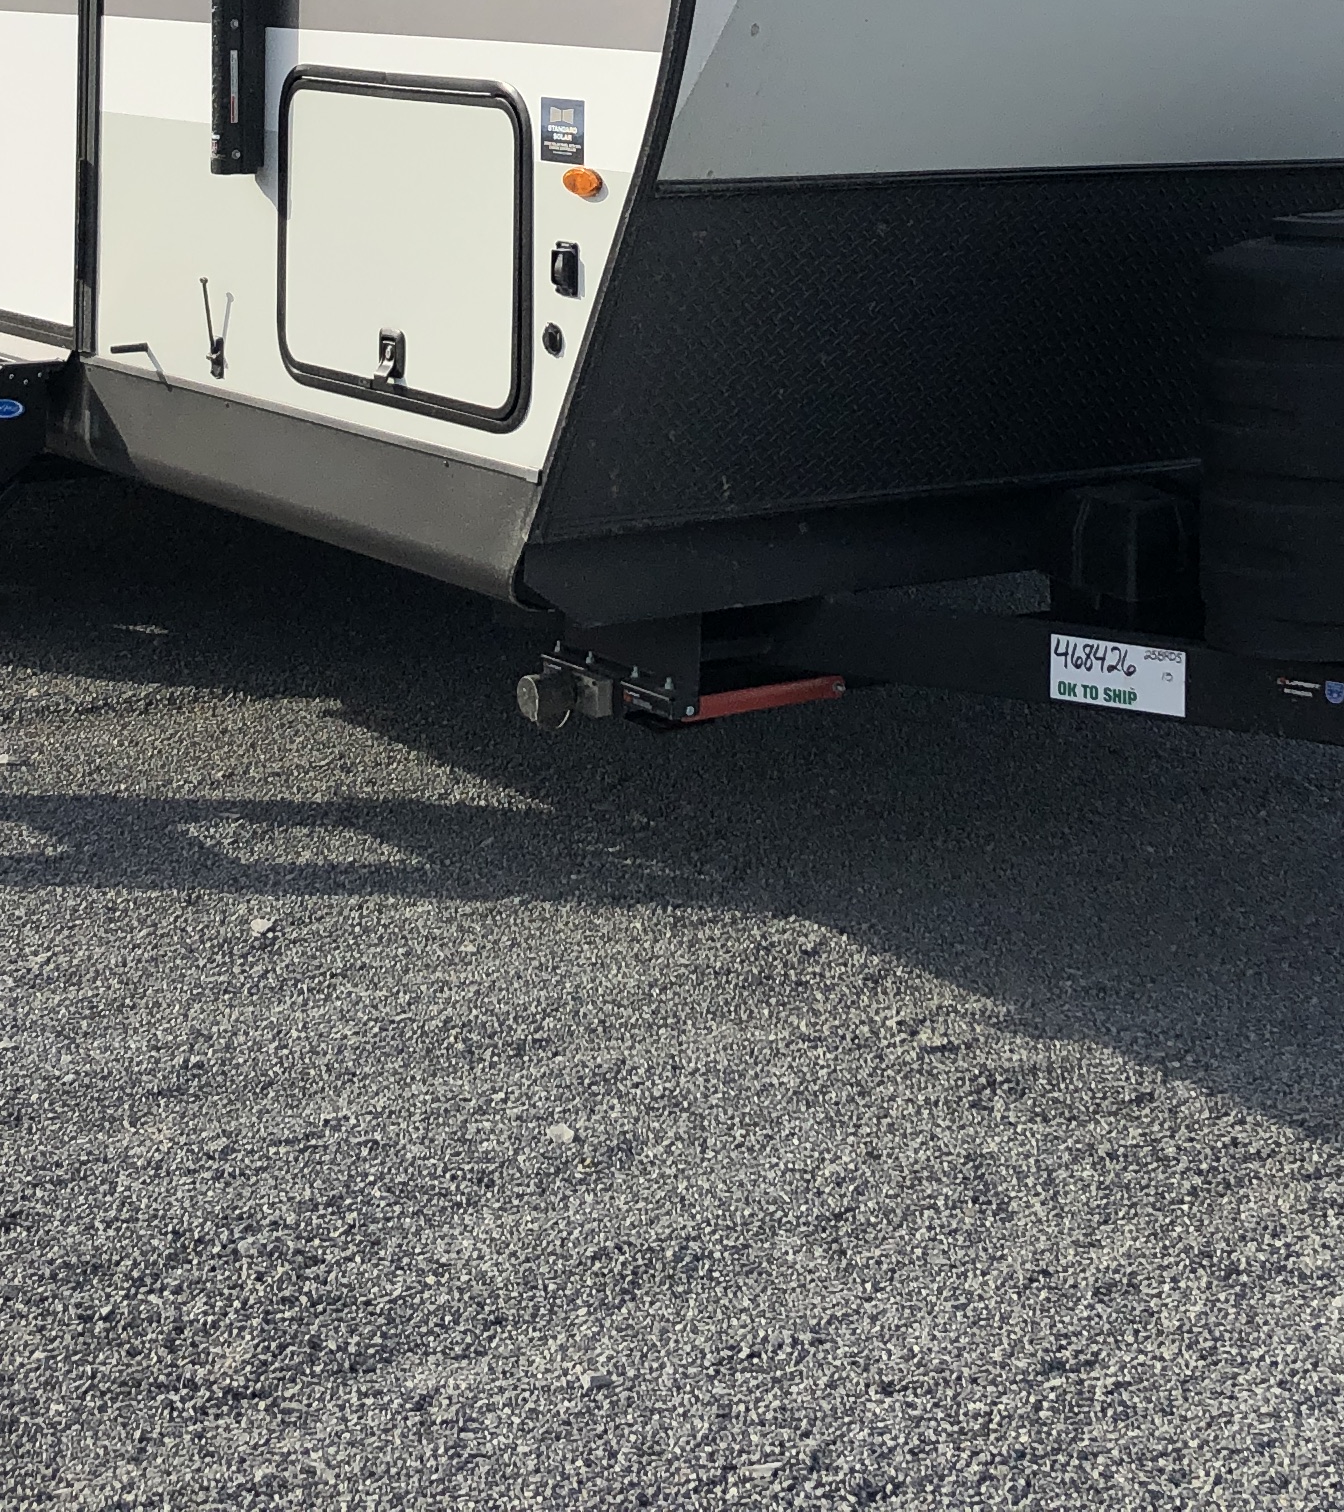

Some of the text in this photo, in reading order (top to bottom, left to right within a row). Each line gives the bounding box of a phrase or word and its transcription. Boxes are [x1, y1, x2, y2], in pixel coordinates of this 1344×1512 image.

[1053, 637, 1137, 677] 468426
[1057, 680, 1138, 706] OK TO SHIP
